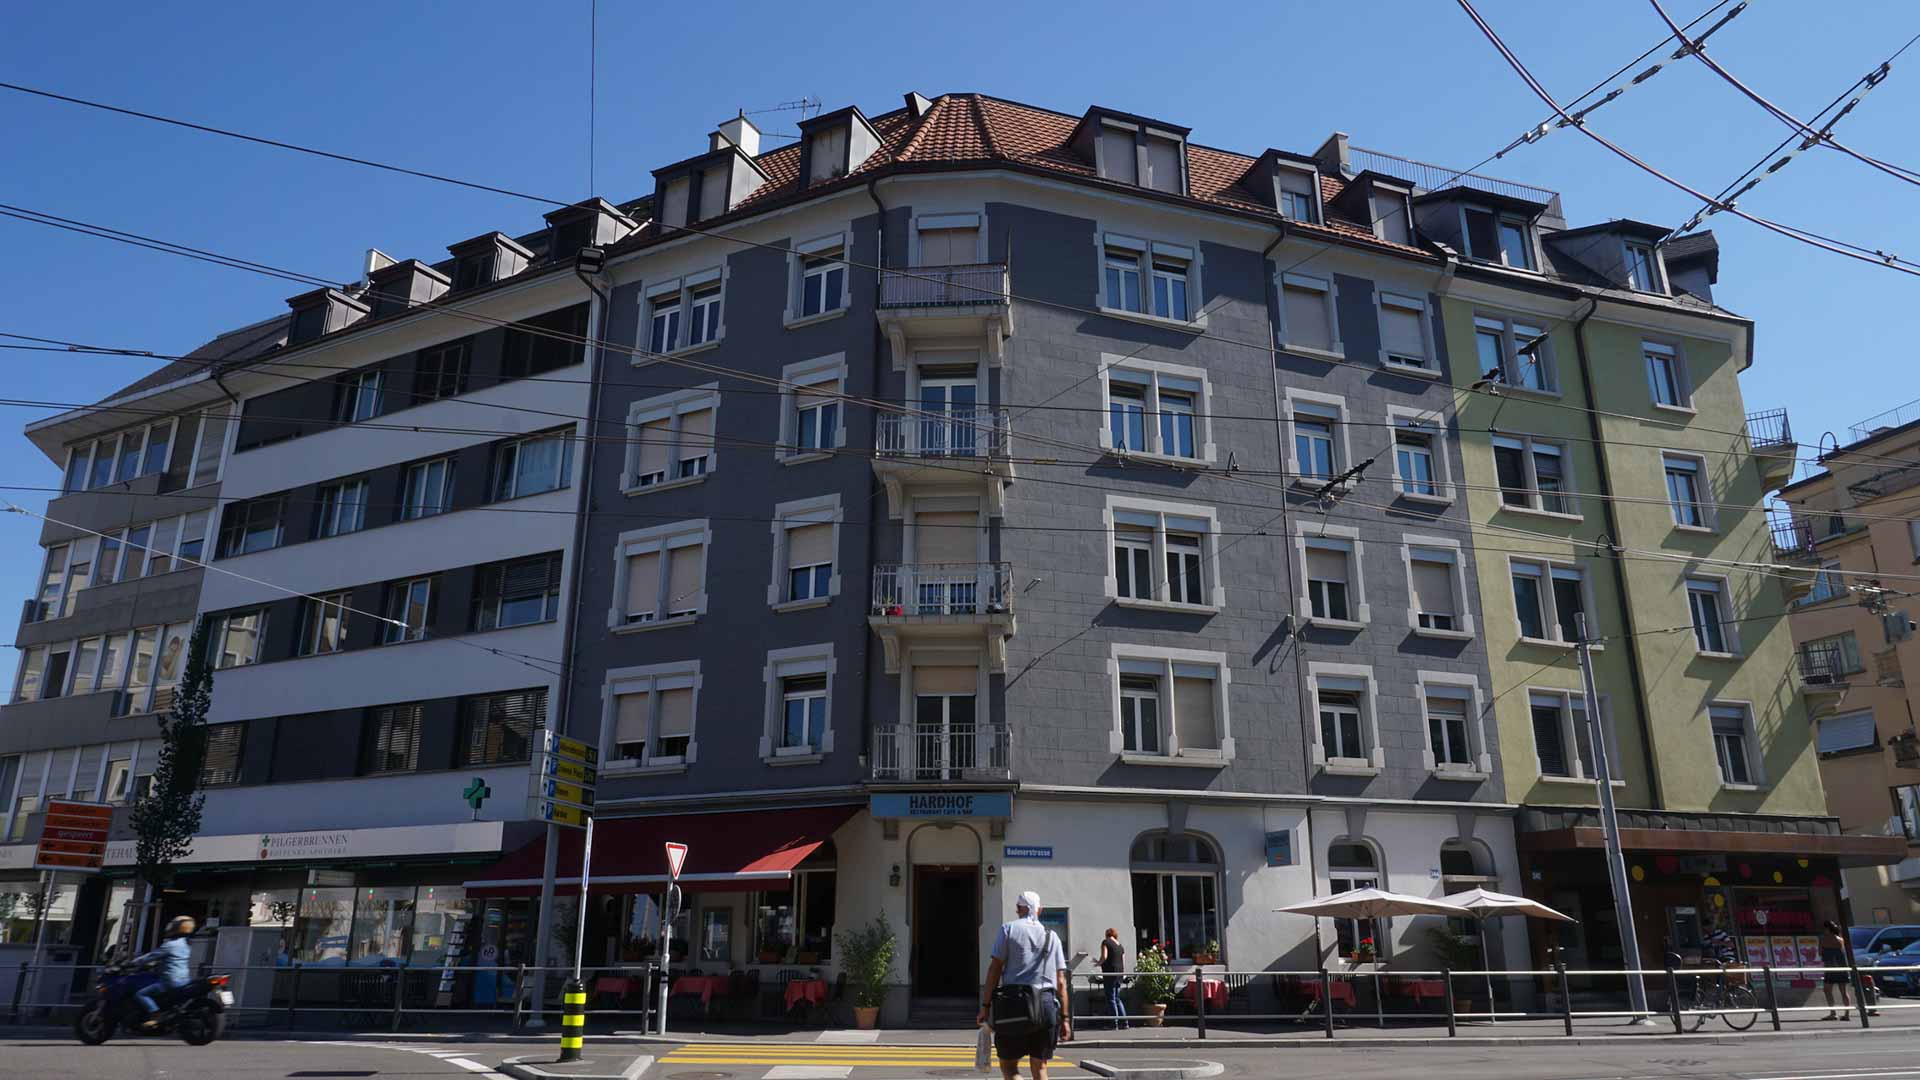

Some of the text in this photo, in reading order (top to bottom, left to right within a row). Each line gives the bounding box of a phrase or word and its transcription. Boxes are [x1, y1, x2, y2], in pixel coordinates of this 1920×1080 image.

[910, 795, 974, 808] HARDHOF
[271, 834, 347, 847] PILGERBRUNNEN
[1006, 847, 1051, 857] Badenerstrasse
